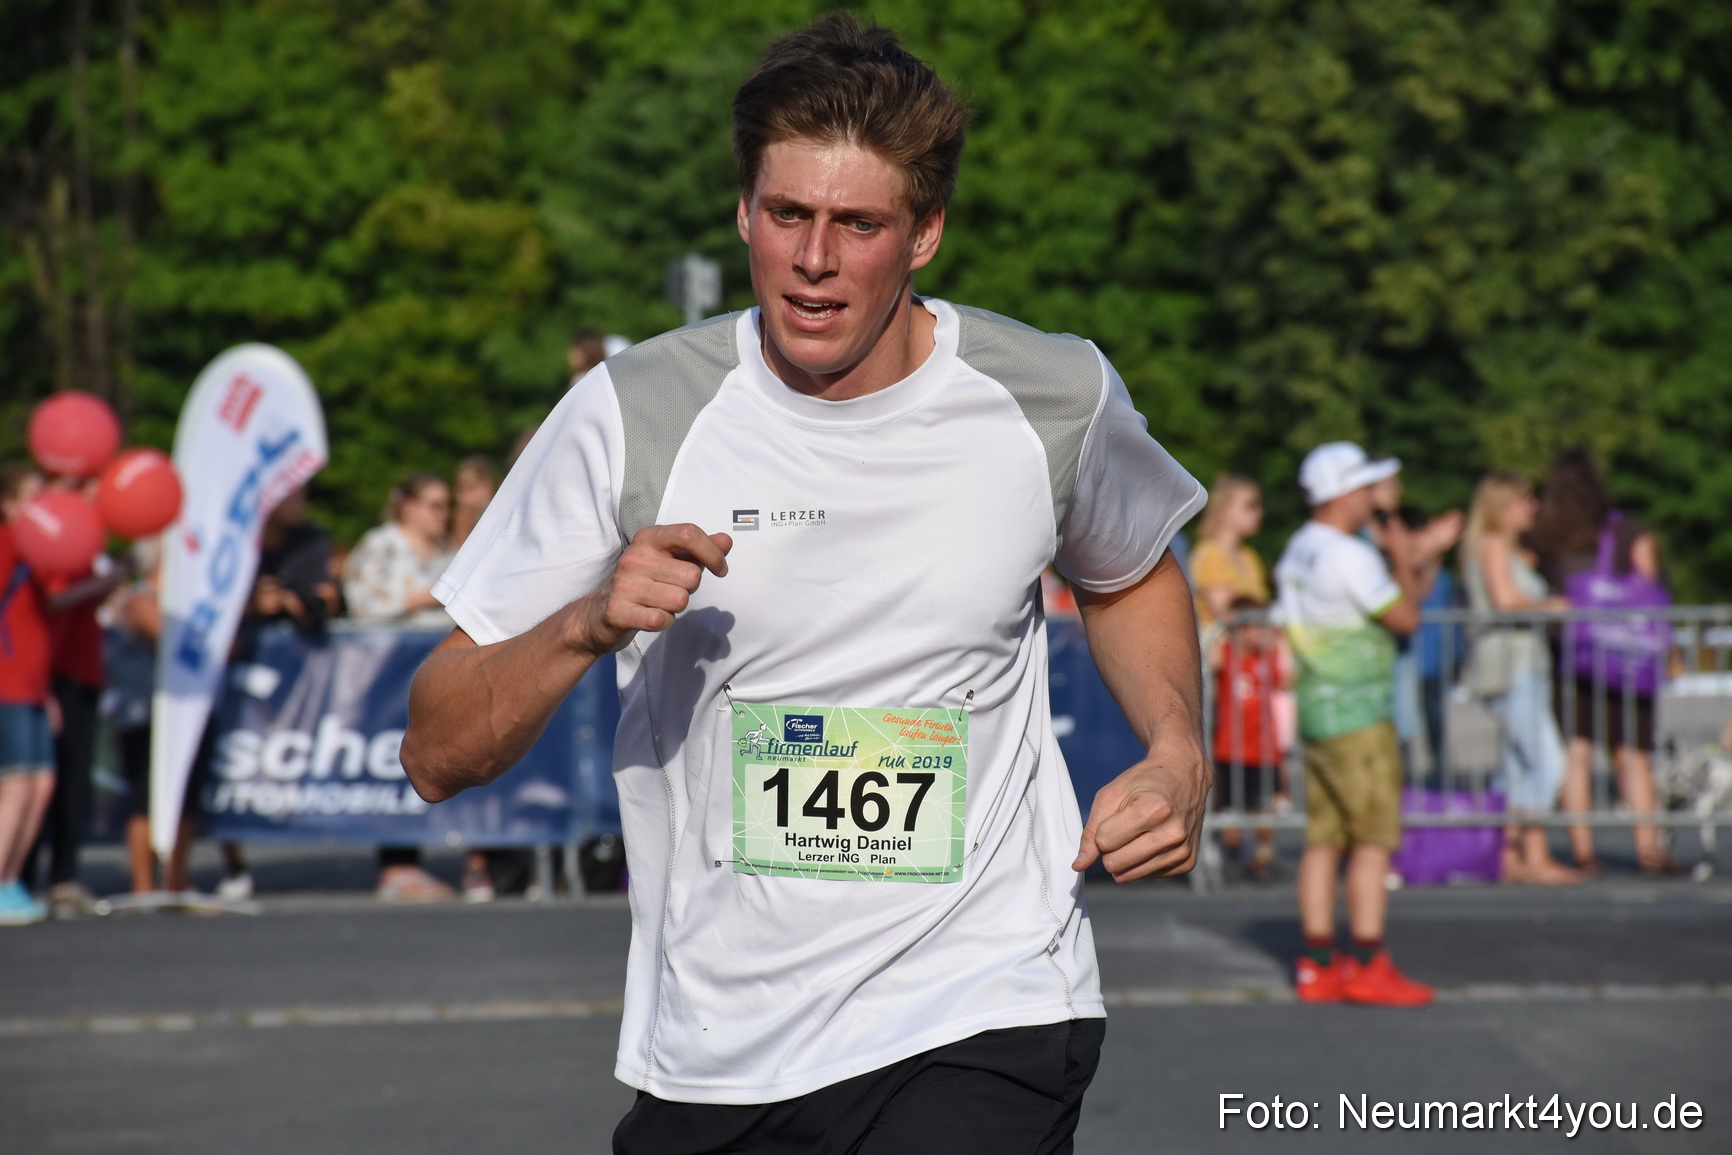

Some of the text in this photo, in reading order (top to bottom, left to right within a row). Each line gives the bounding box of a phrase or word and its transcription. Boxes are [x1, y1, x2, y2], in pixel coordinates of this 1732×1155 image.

[771, 510, 825, 521] LERZER
[791, 721, 818, 729] Fischer
[882, 713, 954, 732] Gesunde Firmen
[899, 726, 927, 740] laufen
[768, 738, 859, 756] firmenlauf
[878, 755, 953, 769] run 2019
[763, 767, 936, 832] 1467
[785, 832, 912, 853] Hartwig Daniel
[798, 851, 896, 864] Lerzer ING Plan
